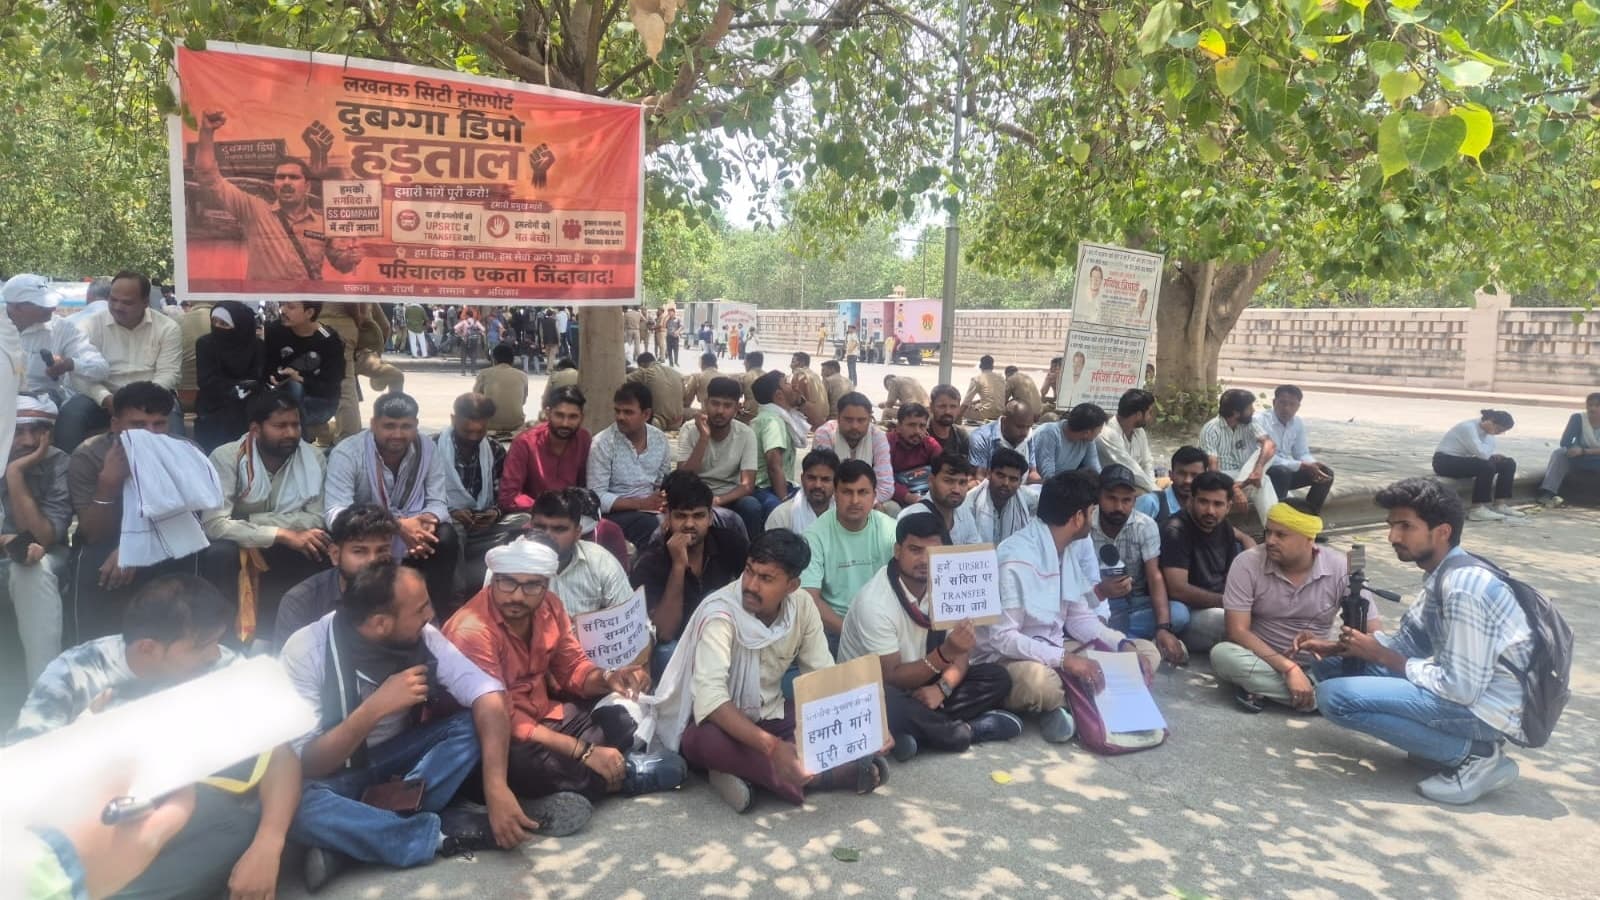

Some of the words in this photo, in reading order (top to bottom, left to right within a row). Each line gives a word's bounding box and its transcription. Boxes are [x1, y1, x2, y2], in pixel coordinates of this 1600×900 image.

[343, 76, 409, 96] लखनऊ
[415, 81, 451, 103] सिटी
[456, 89, 514, 110] ट्रांसपोर्ट
[336, 101, 449, 136] दुबग्गा
[458, 110, 525, 143] डिपो
[345, 136, 525, 182] हड़ताल
[394, 185, 422, 198] हमारी
[448, 186, 463, 200] पूरी
[466, 186, 489, 198] करो!
[328, 208, 338, 218] SS
[340, 208, 378, 218] COMPANY
[339, 222, 354, 233] नहीं
[356, 223, 379, 232] जाना!
[426, 221, 461, 232] UPSRTC
[424, 232, 462, 241] TRANSFER
[415, 249, 427, 258] हम
[378, 259, 466, 280] परिचालक
[472, 266, 527, 283] एकता
[533, 264, 614, 285] जिंदाबाद!
[936, 559, 952, 573] हमें
[958, 560, 990, 571] UPSRTC
[934, 574, 943, 586] में
[982, 573, 992, 583] पर
[942, 589, 986, 600] TRANSFER
[941, 602, 965, 614] किया
[808, 719, 842, 744] हमारी
[816, 744, 838, 769] पूरी
[846, 733, 868, 754] करो
